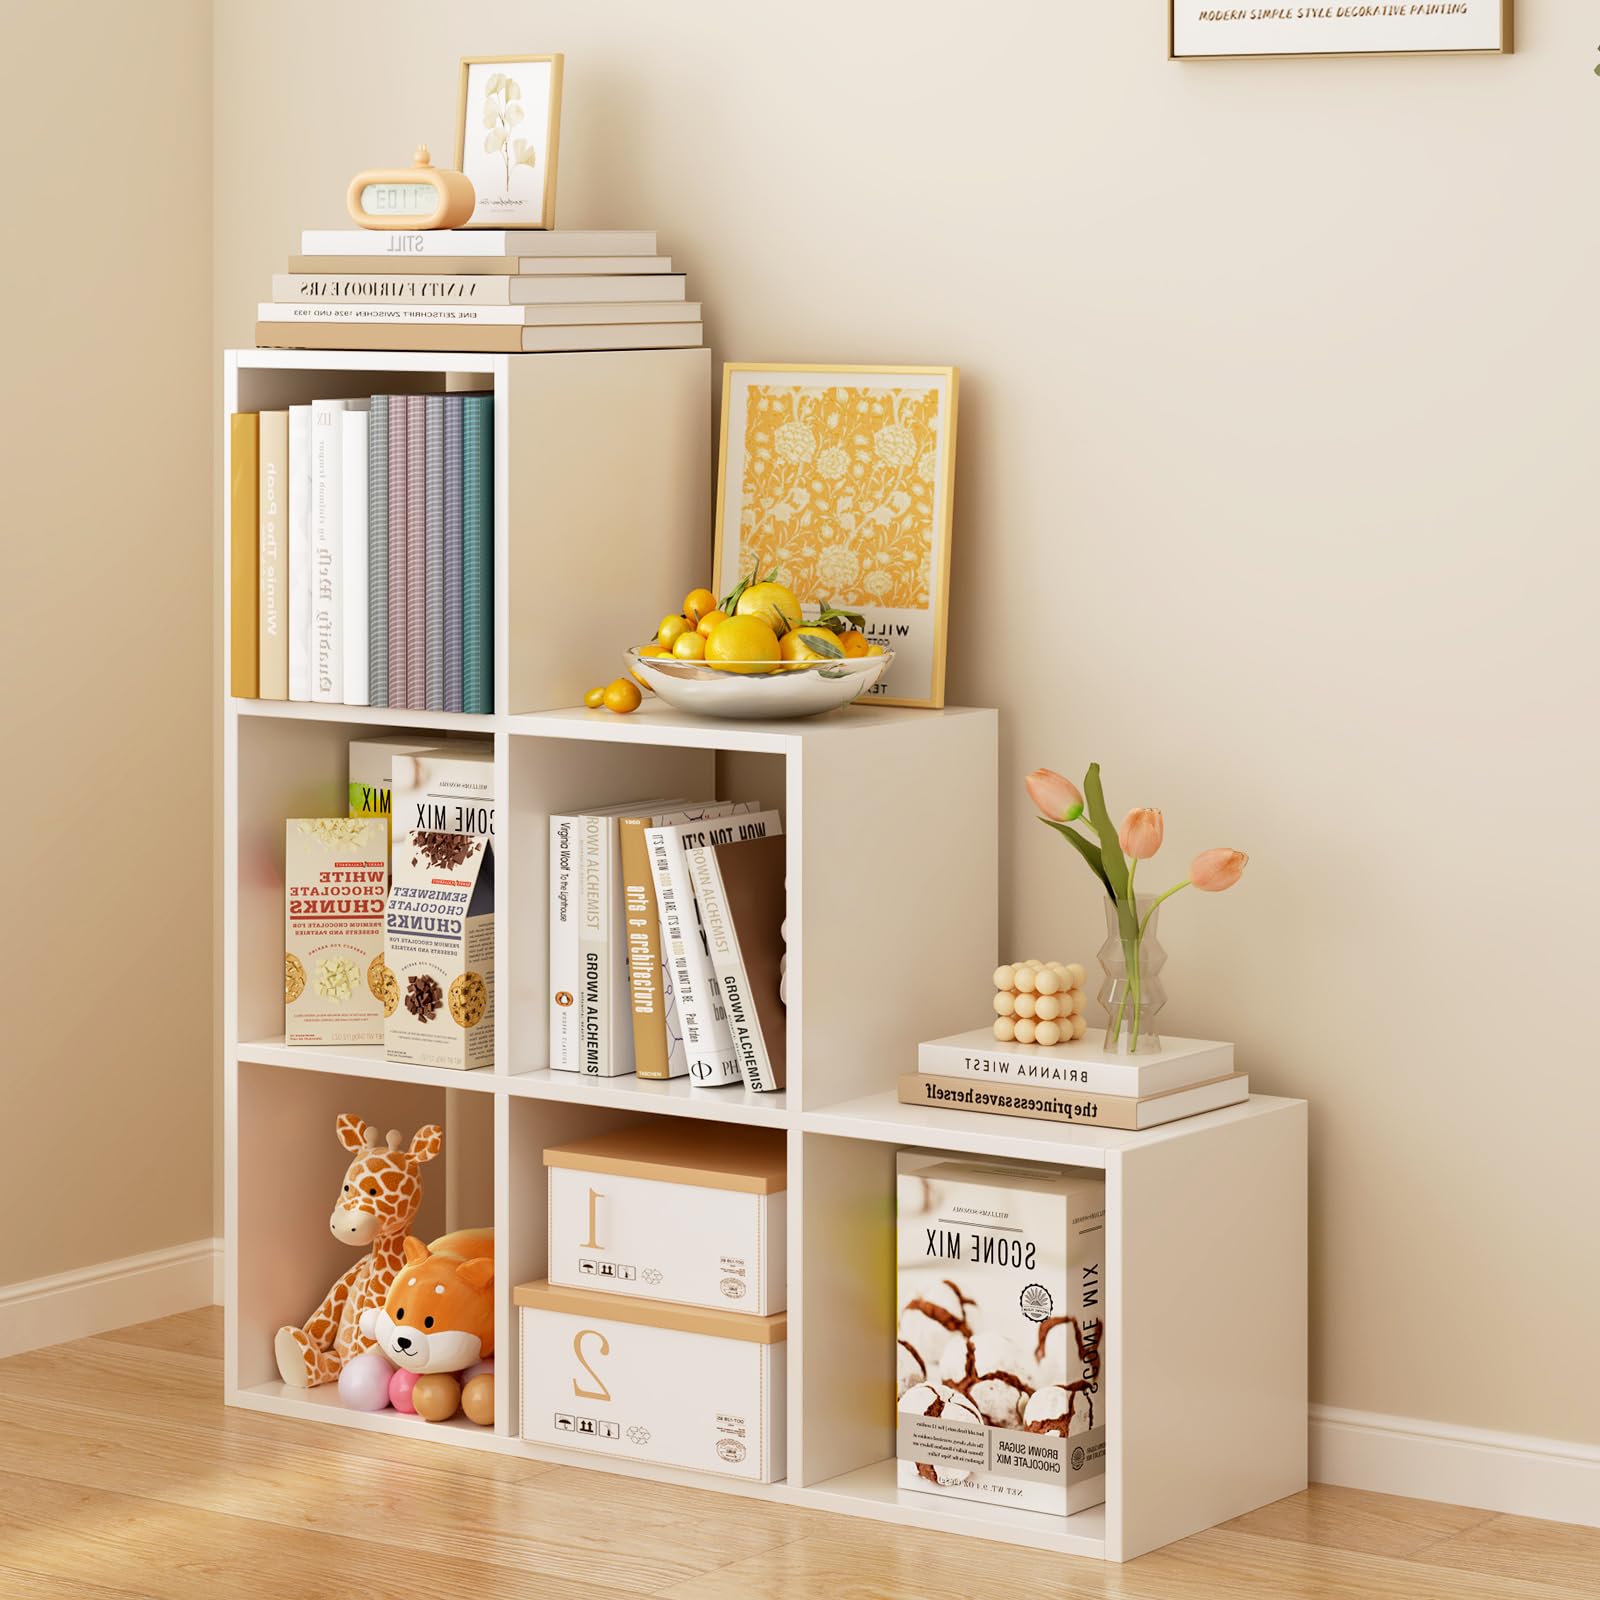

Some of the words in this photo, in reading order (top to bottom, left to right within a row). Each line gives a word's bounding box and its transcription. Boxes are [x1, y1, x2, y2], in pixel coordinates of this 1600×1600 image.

[1199, 10, 1247, 21] MODERN
[1250, 8, 1293, 20] SIMPLE
[1297, 7, 1333, 19] STYLE
[1336, 4, 1407, 18] DECORATIVE
[1410, 3, 1468, 16] PAINTING
[558, 822, 571, 849] Virginia
[586, 817, 600, 856] ROWN
[709, 827, 734, 846] NOT
[560, 850, 571, 871] Woolf
[654, 846, 666, 858] NOT
[657, 859, 668, 871] HOW
[560, 881, 568, 890] the
[586, 859, 600, 930] ALCHEMIST
[627, 885, 650, 911] arts
[662, 888, 674, 900] YOU
[558, 890, 569, 922] Lighthouse
[691, 848, 711, 886] ROWN
[702, 888, 730, 954] ALCHEMIST
[587, 952, 599, 1002] GROWN
[630, 933, 654, 1013] architecture
[587, 1006, 599, 1076] ALCHEMIS
[724, 976, 745, 1023] GROWN
[736, 1027, 763, 1093] ALCHEMIS
